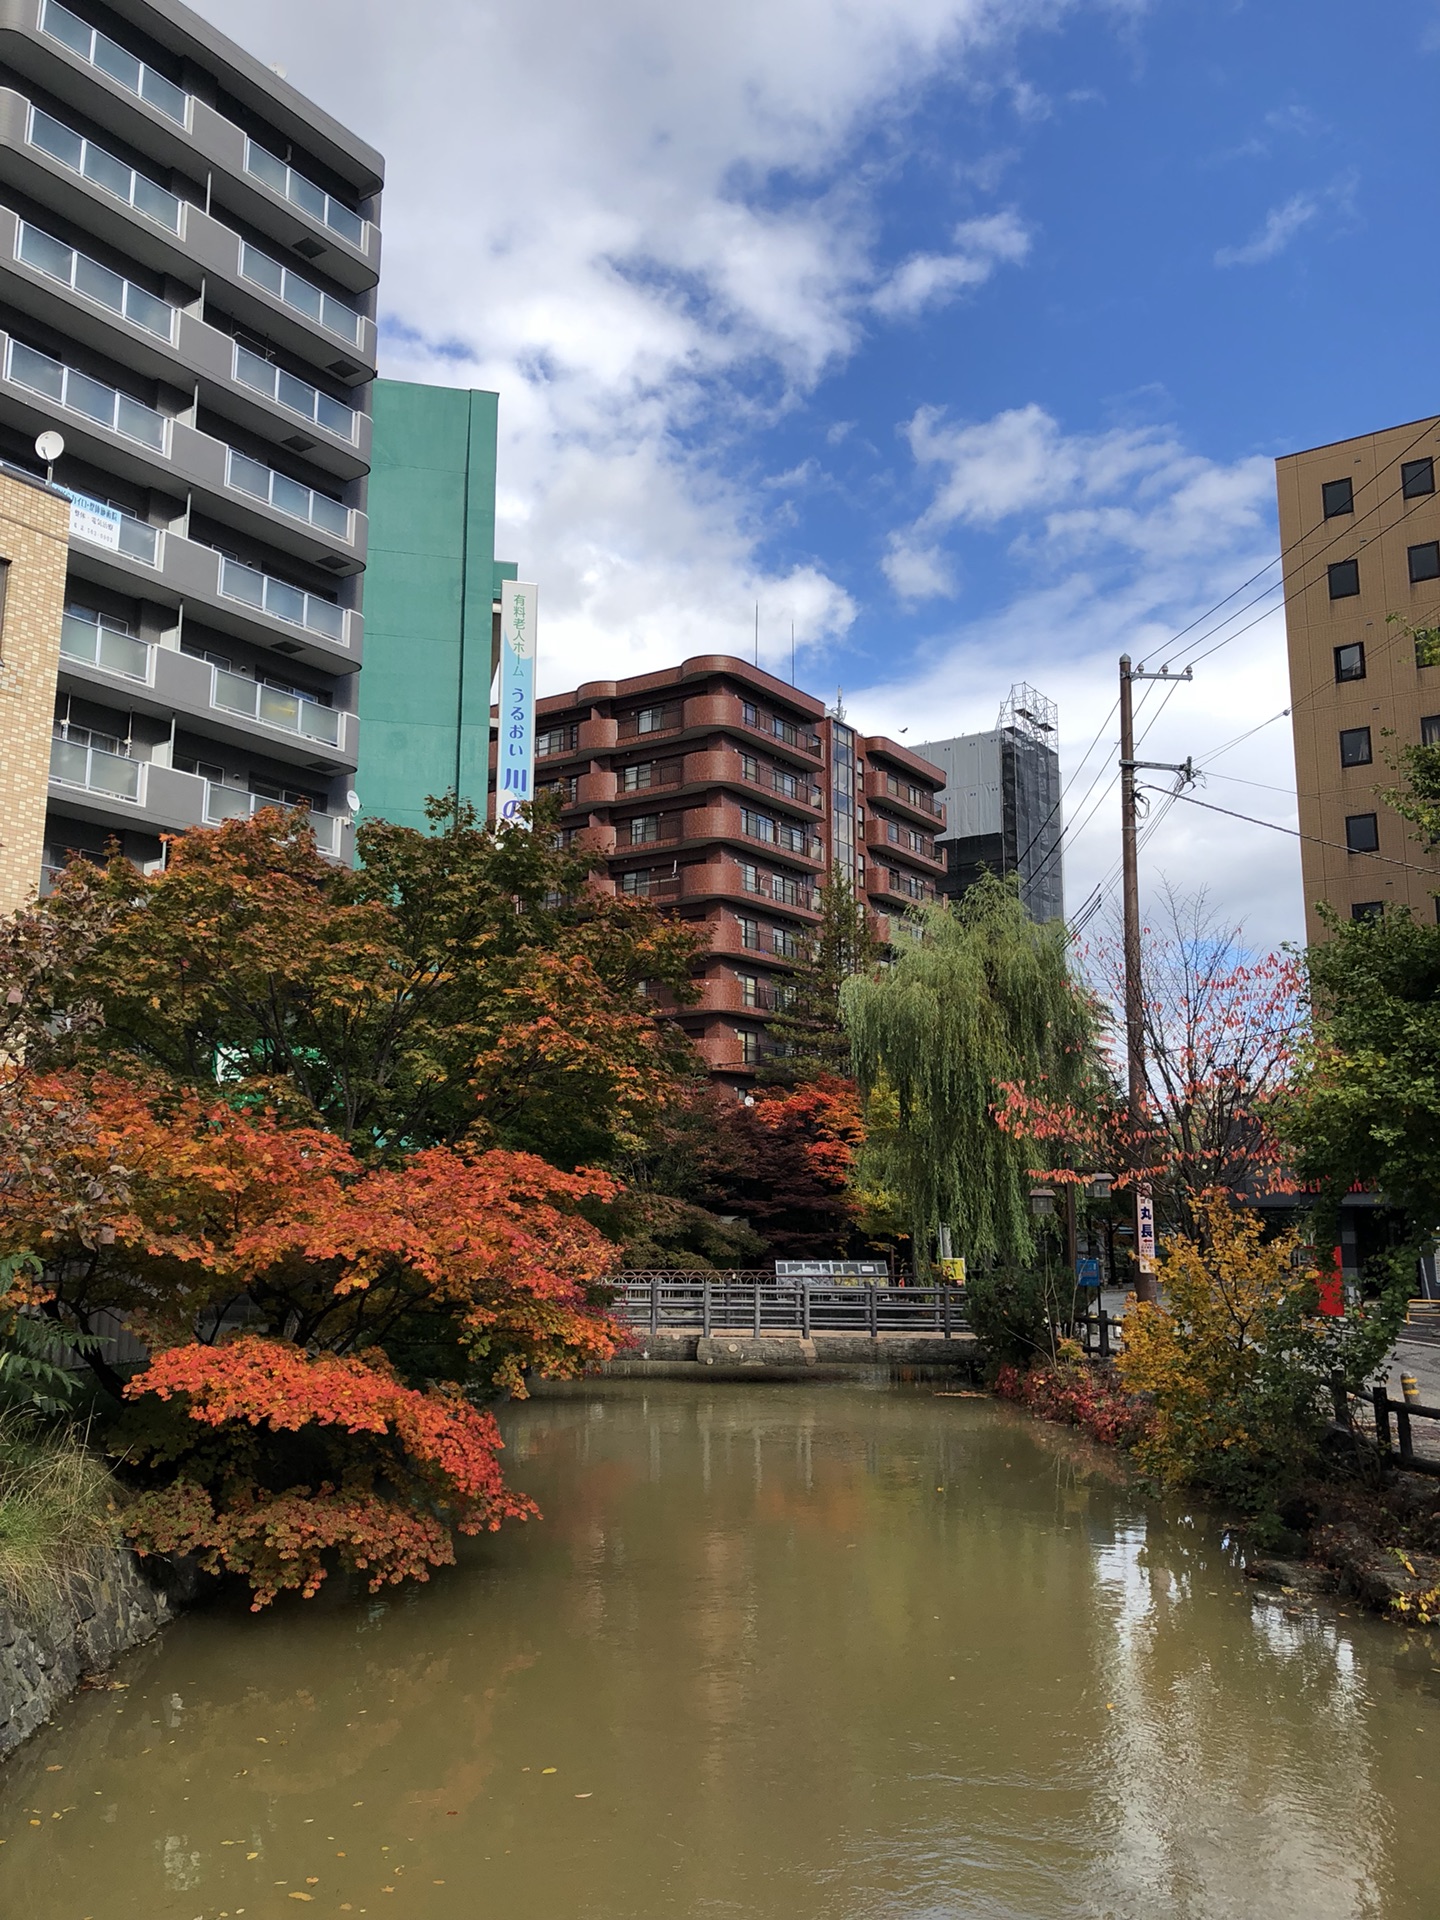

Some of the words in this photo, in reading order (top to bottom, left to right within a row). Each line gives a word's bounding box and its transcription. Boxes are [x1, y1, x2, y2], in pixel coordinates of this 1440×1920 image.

[512, 593, 526, 678] 有料老人ホーム
[508, 687, 525, 757] うるおい
[1140, 1206, 1153, 1238] 丸長
